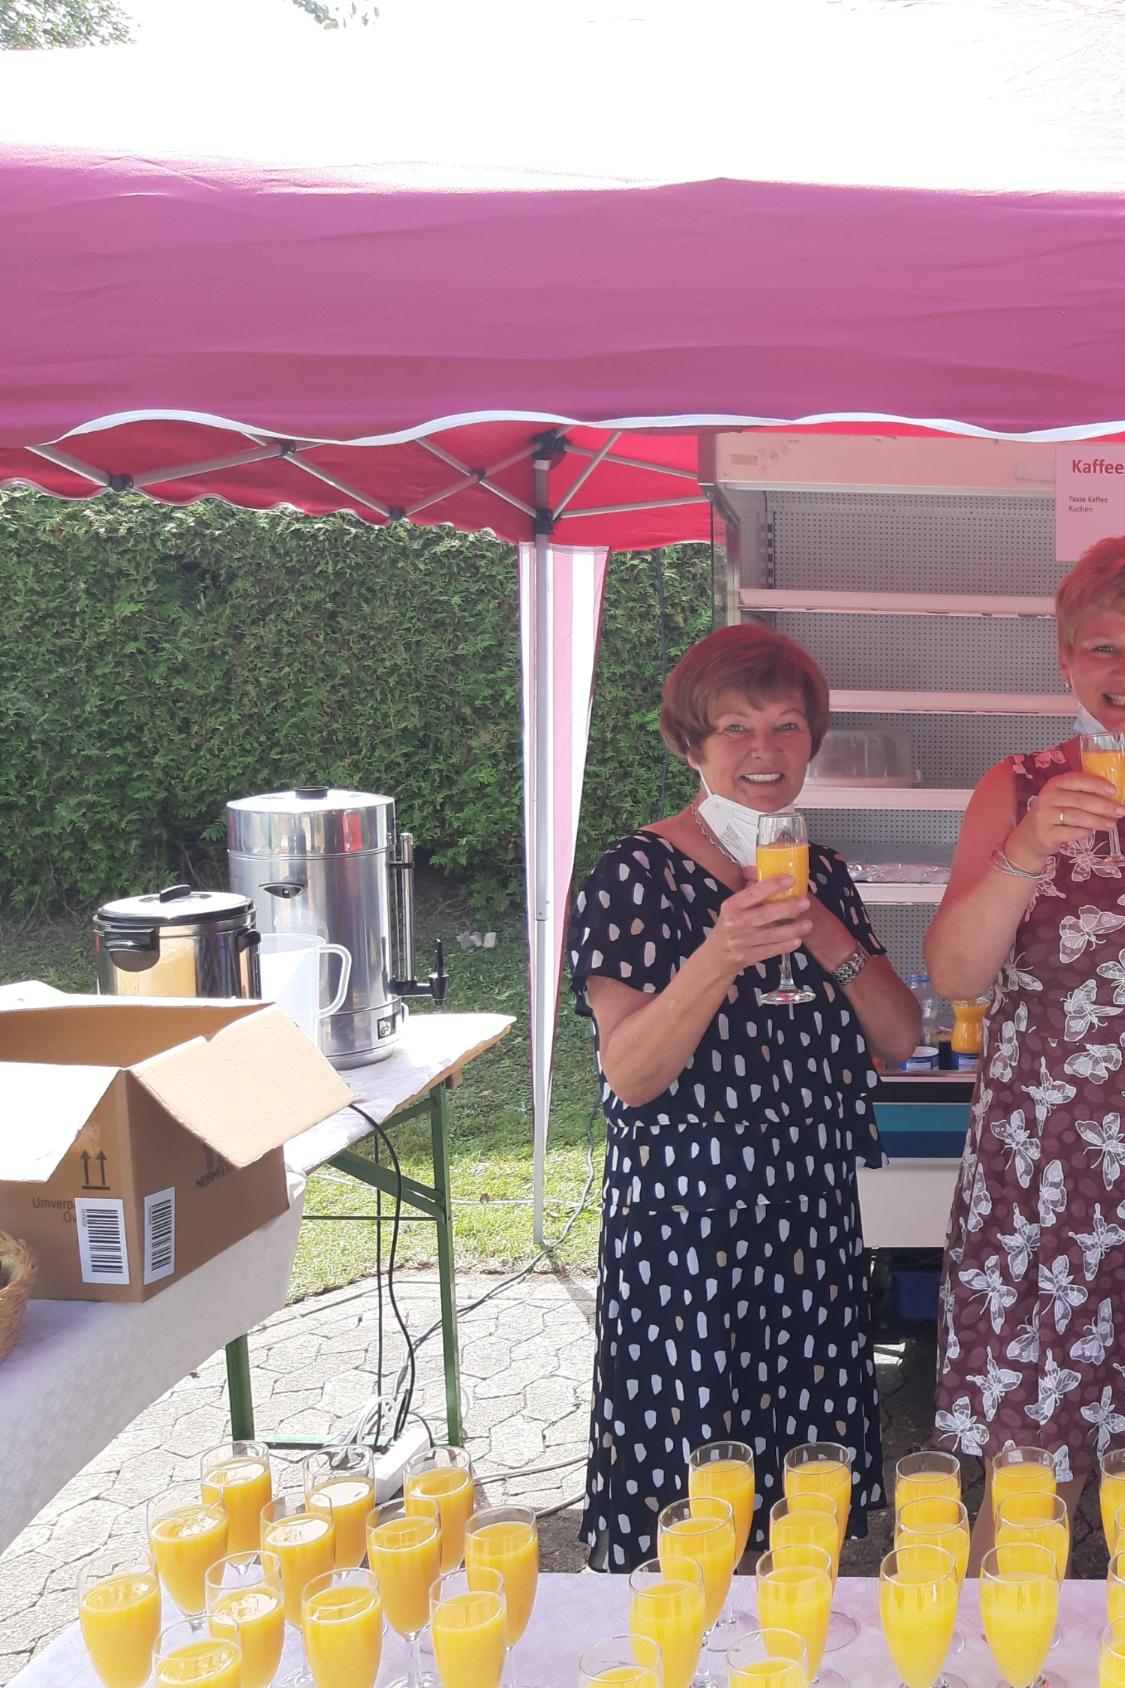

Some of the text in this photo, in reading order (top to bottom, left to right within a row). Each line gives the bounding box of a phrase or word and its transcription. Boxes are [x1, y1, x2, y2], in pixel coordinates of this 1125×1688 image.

[1072, 459, 1124, 475] Kaffee
[1068, 495, 1086, 503] Tasse
[1087, 495, 1109, 504] Kaffee
[1068, 505, 1093, 513] Kuchen
[32, 1197, 74, 1211] Umverp
